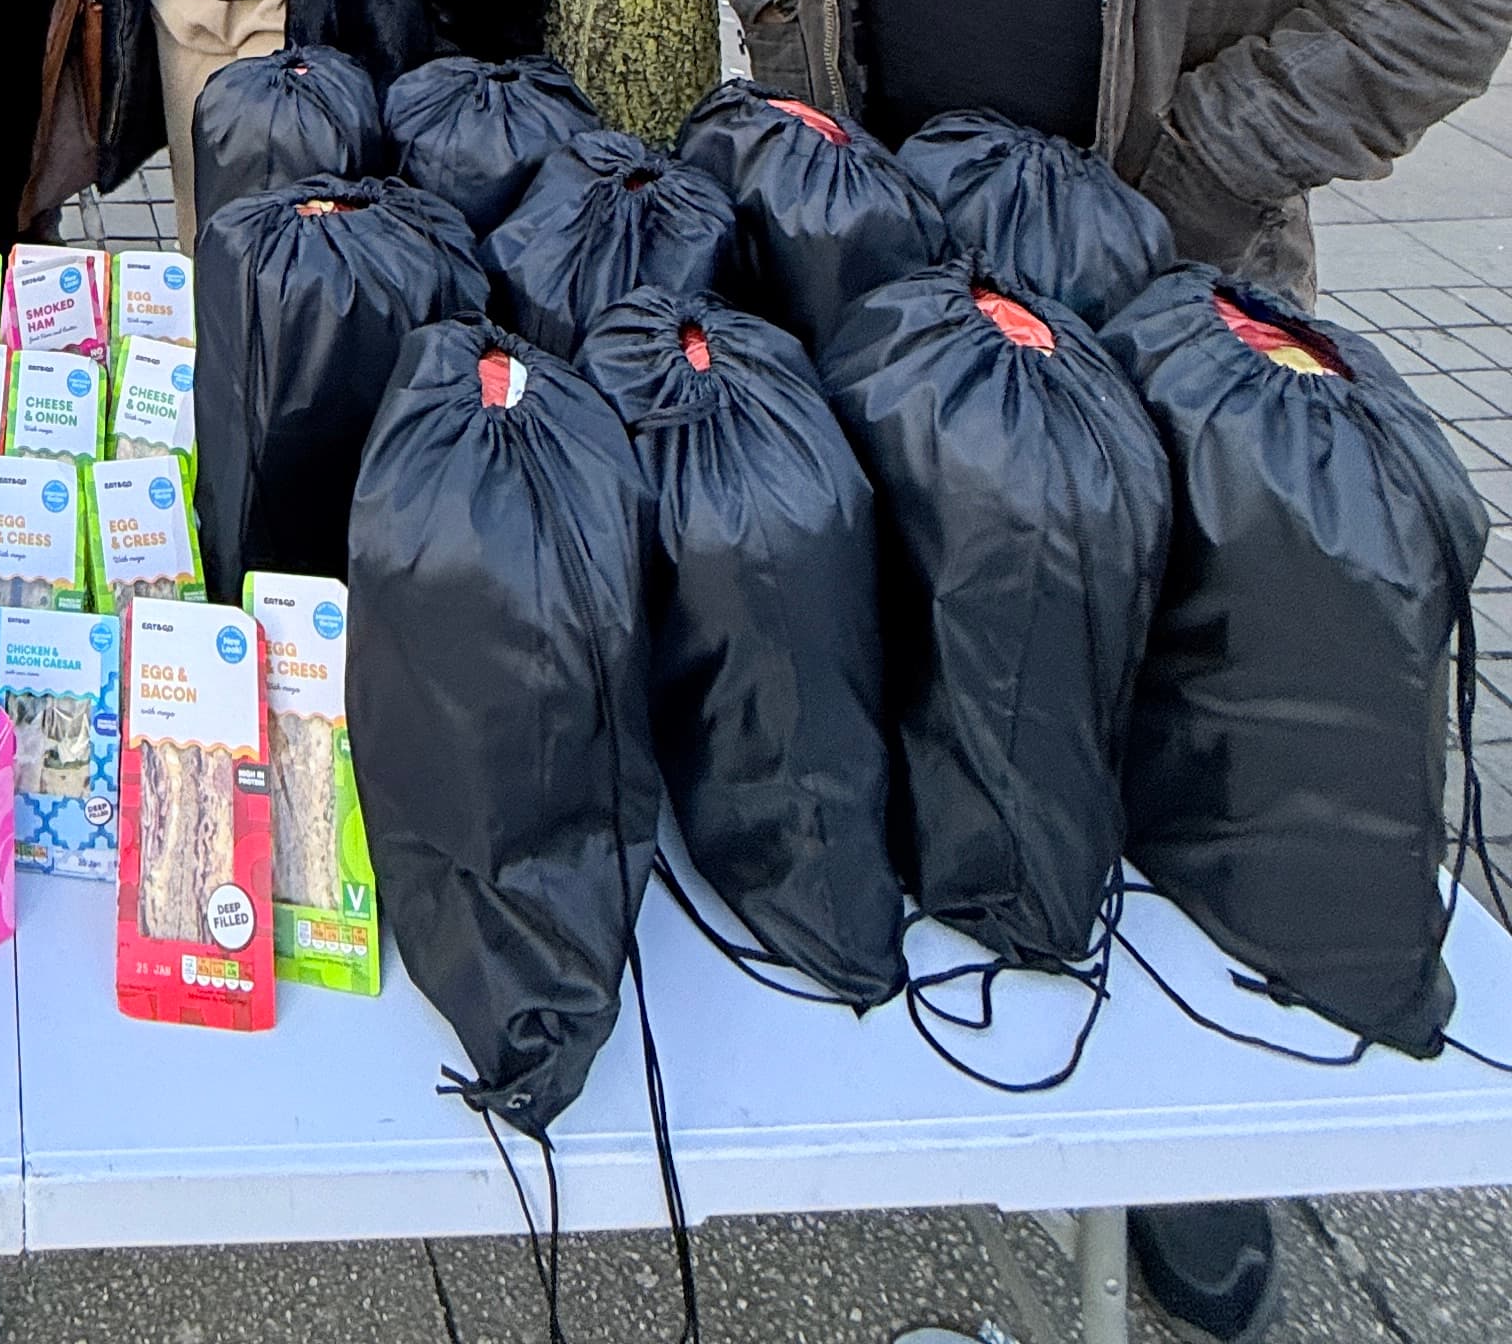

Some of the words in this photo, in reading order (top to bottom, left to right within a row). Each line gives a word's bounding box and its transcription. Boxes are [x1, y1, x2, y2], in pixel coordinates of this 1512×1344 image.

[127, 291, 152, 302] EGG
[25, 298, 75, 320] SMOKED
[127, 303, 135, 313] &
[136, 304, 174, 316] CRESS
[27, 317, 56, 333] HAM
[128, 385, 175, 405] CHEESE
[25, 396, 73, 412] CHEESE
[126, 400, 134, 410] &
[136, 403, 178, 420] ONION
[24, 412, 33, 422] &
[35, 413, 78, 427] ONION
[109, 518, 139, 533] EGG
[7, 532, 52, 548] CRESS
[111, 537, 120, 549] &
[122, 532, 167, 548] CRESS
[141, 622, 174, 632] EAT&GO
[6, 643, 50, 657] CHICKEN
[52, 648, 59, 657] &
[6, 655, 41, 667] BACON
[43, 658, 82, 670] CAESAR
[140, 664, 174, 681] EGG
[177, 667, 188, 682] &
[277, 662, 328, 680] CRESS
[140, 683, 198, 703] BACON
[87, 803, 107, 813] DEEP
[346, 883, 365, 911] V
[217, 902, 241, 915] DEEP
[153, 965, 171, 976] JAN
